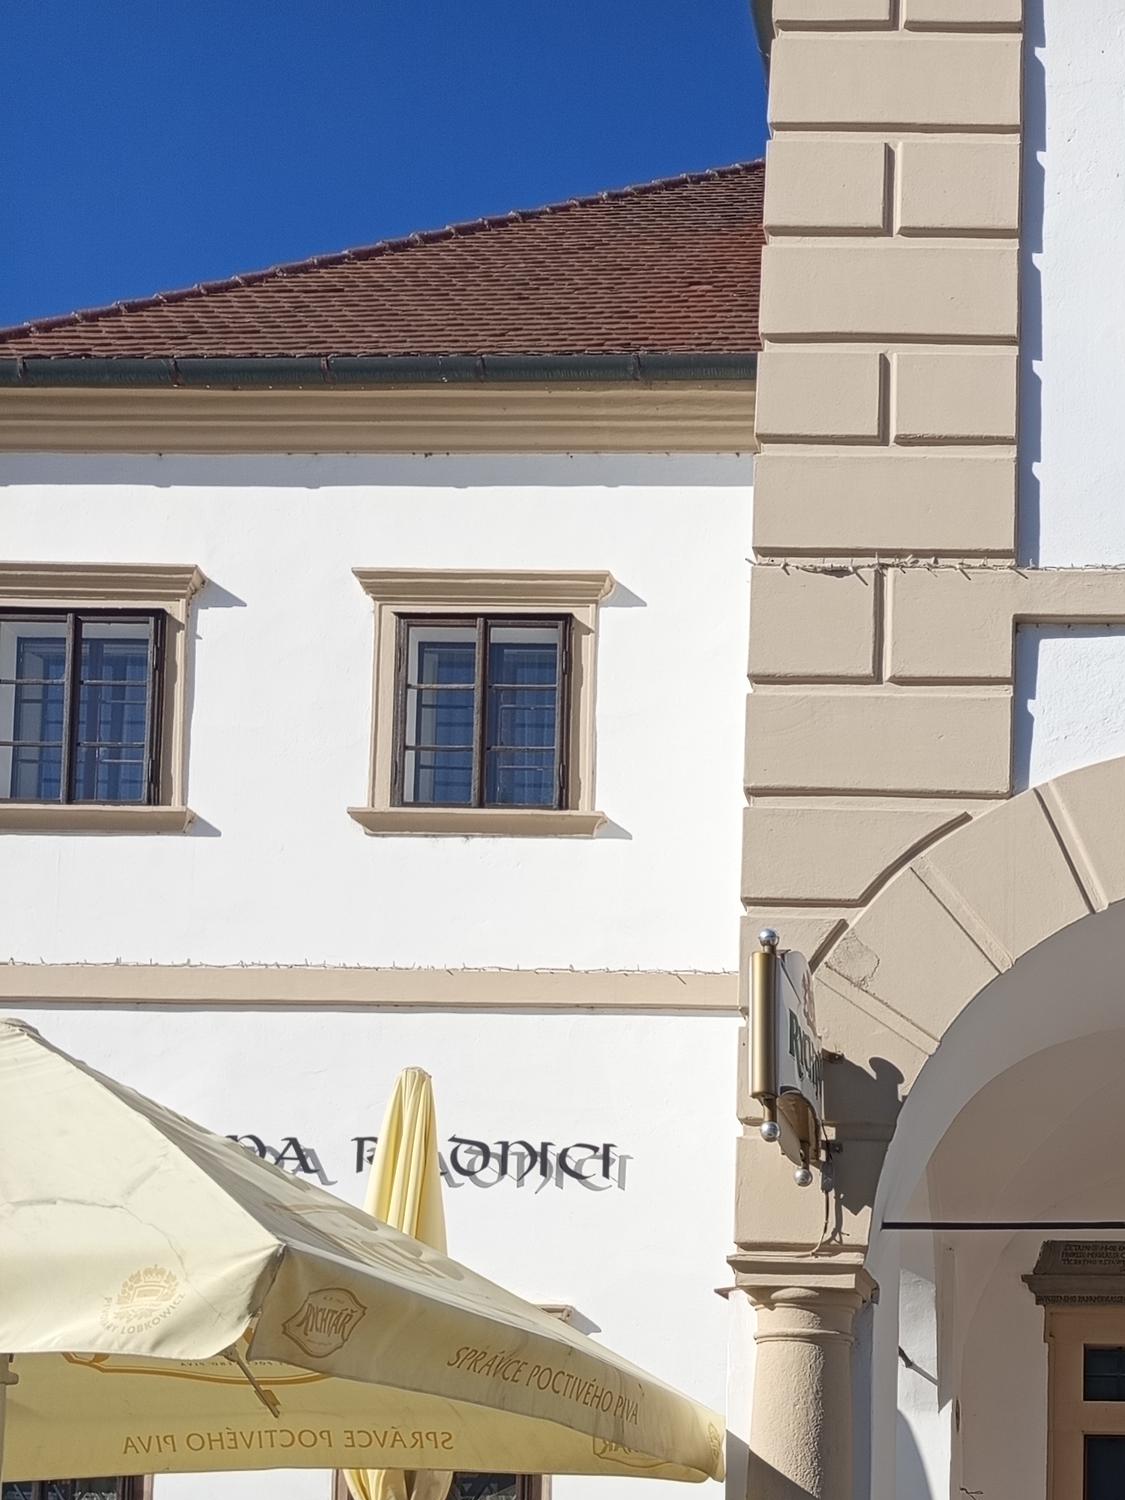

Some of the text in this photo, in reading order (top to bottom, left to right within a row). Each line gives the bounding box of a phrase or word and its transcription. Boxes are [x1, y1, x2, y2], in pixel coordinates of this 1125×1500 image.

[351, 1133, 619, 1182] RDNICI
[447, 1346, 640, 1426] SPRÁVCE POCTIVÉHO PIVA
